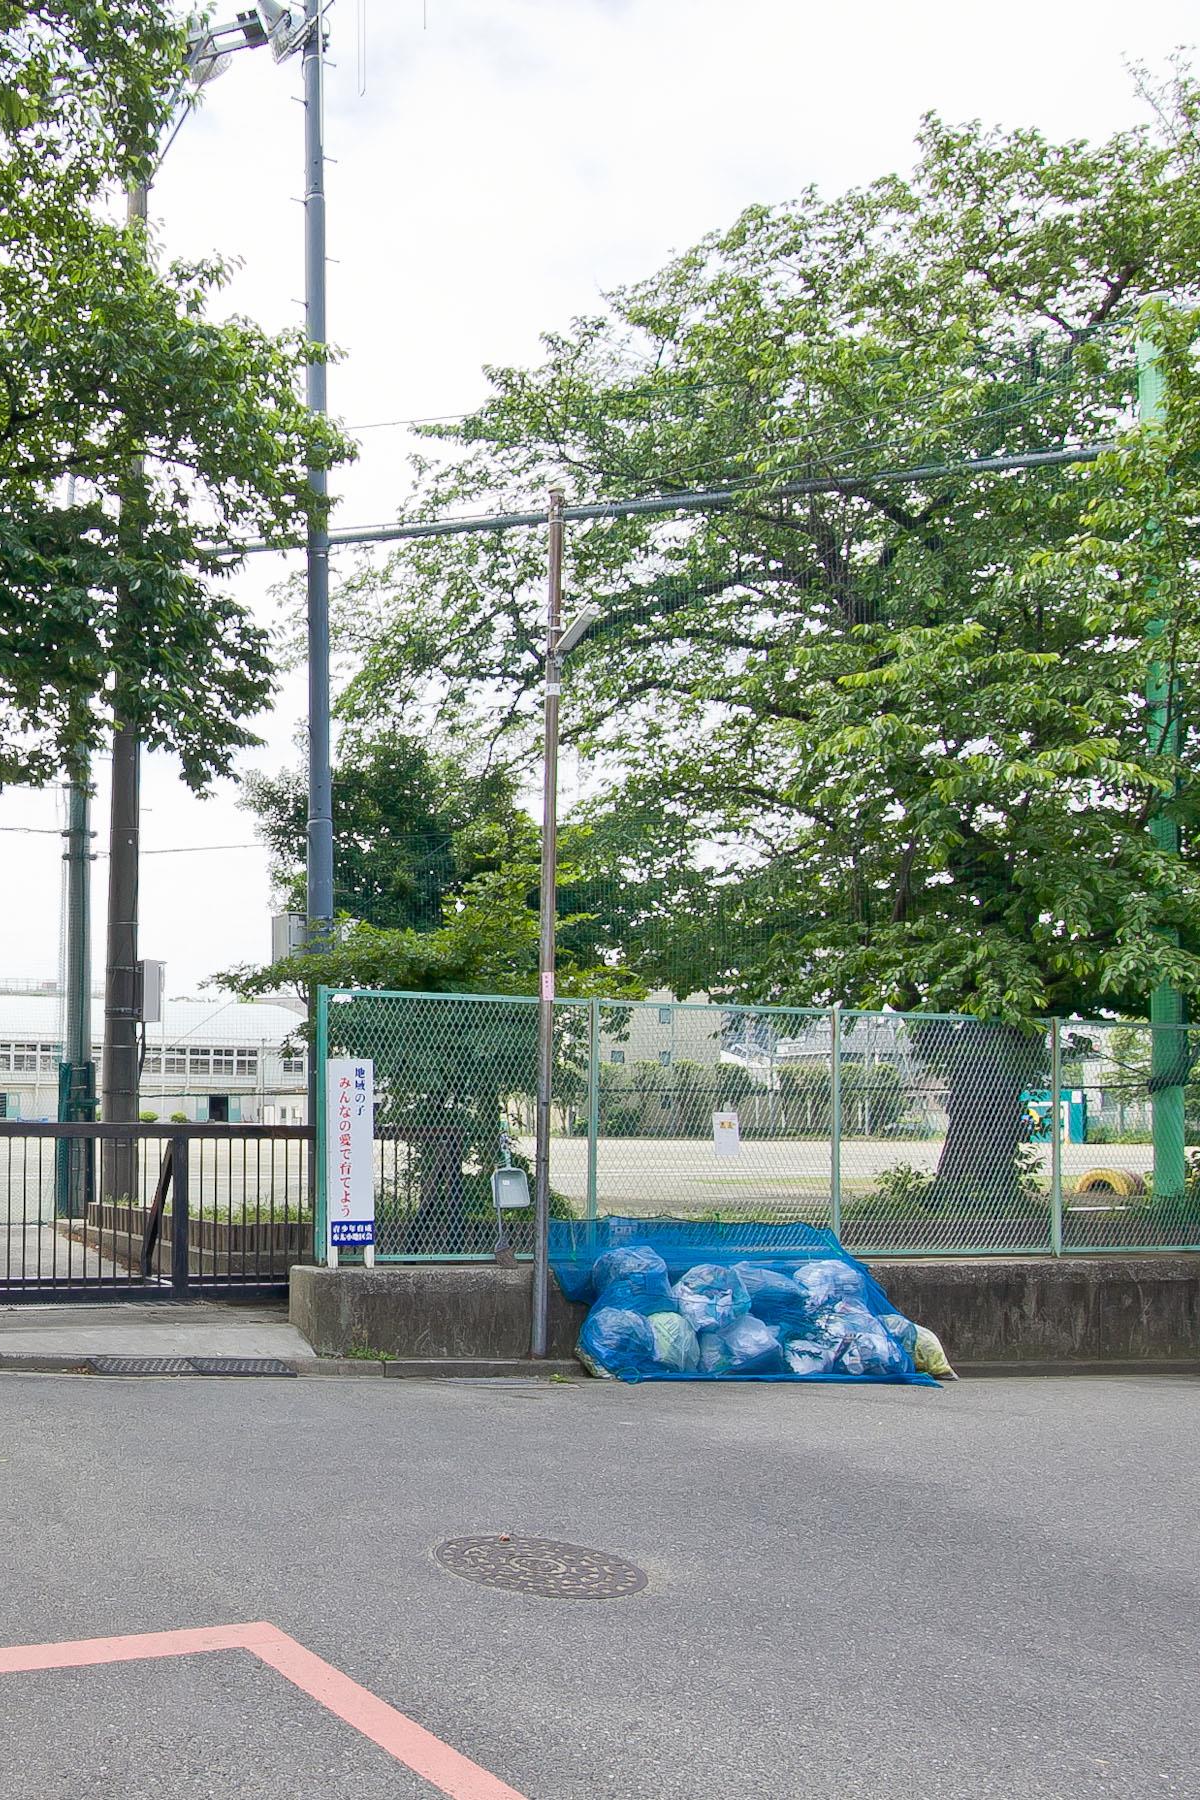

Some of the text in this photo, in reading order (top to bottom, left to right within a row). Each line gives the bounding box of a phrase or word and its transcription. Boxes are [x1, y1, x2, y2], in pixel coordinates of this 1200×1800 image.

[354, 1066, 366, 1117] 地域の子
[338, 1077, 352, 1218] みんなの愛で育てよう
